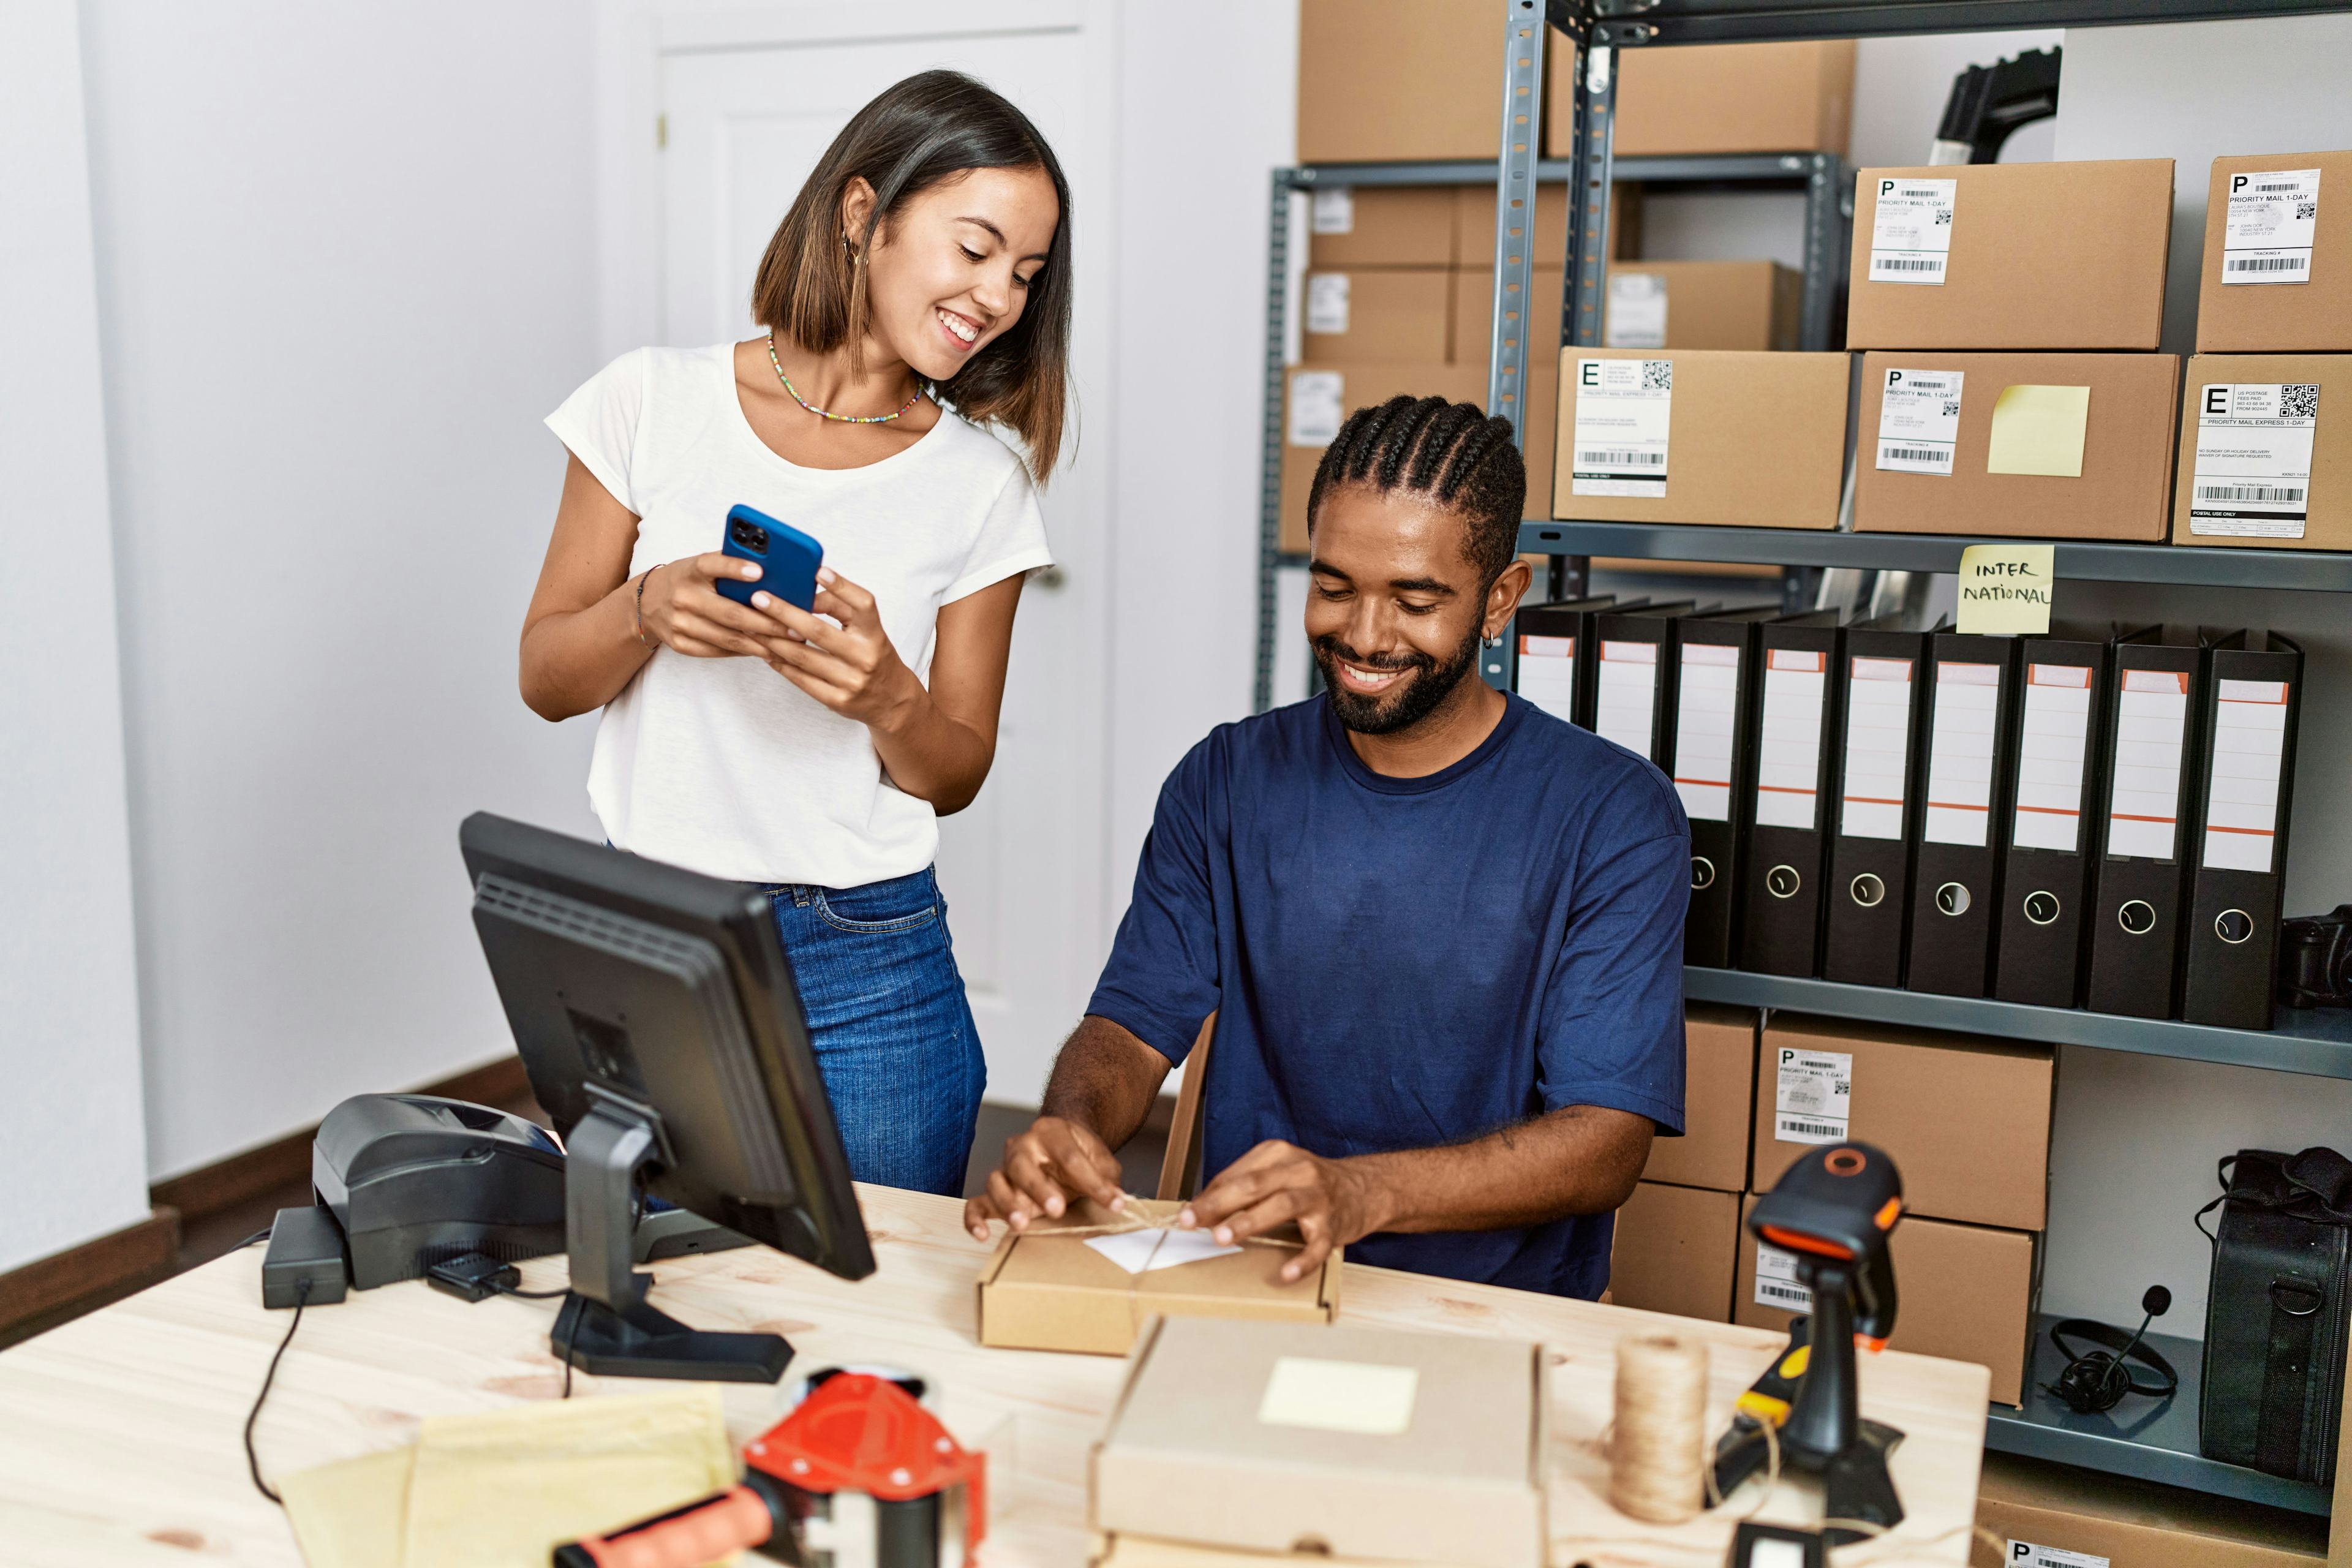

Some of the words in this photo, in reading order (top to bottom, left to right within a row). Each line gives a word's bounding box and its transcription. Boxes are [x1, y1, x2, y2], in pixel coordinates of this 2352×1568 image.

[1882, 181, 1894, 196] P
[2233, 176, 2248, 193] P
[1583, 363, 1599, 385] E
[1889, 371, 1902, 386] P
[2206, 388, 2228, 413] E
[1976, 562, 2039, 577] INTER
[1782, 1050, 1794, 1064] P
[2013, 1543, 2030, 1561] P
